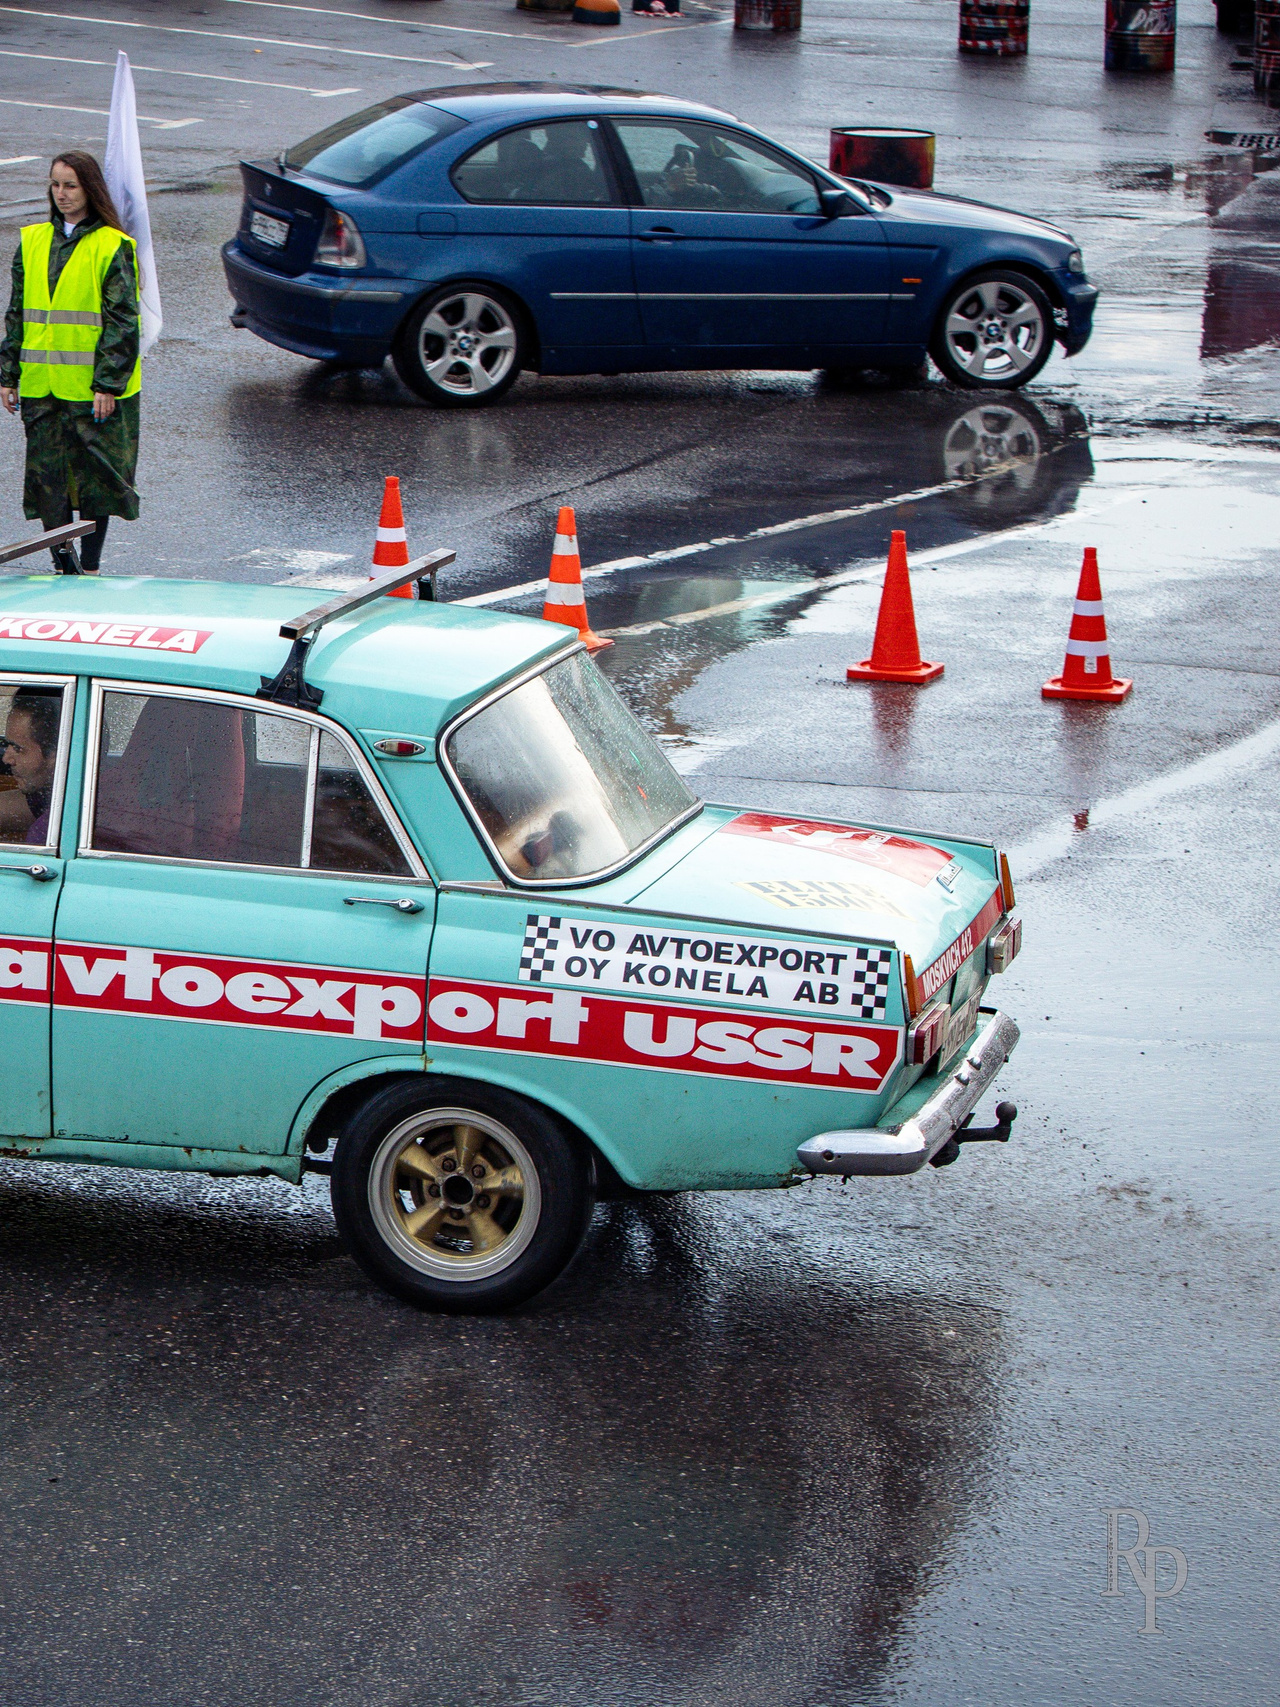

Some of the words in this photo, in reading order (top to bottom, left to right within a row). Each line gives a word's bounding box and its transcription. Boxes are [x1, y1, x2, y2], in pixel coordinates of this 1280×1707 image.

[564, 955, 611, 980] OY
[622, 962, 769, 999] KONELA
[793, 981, 840, 1005] AB
[569, 927, 616, 951] VO
[626, 933, 847, 976] AVTOEXPORT
[923, 940, 962, 1000] MOSKVICH
[962, 926, 974, 964] 412
[623, 1011, 883, 1079] USSR
